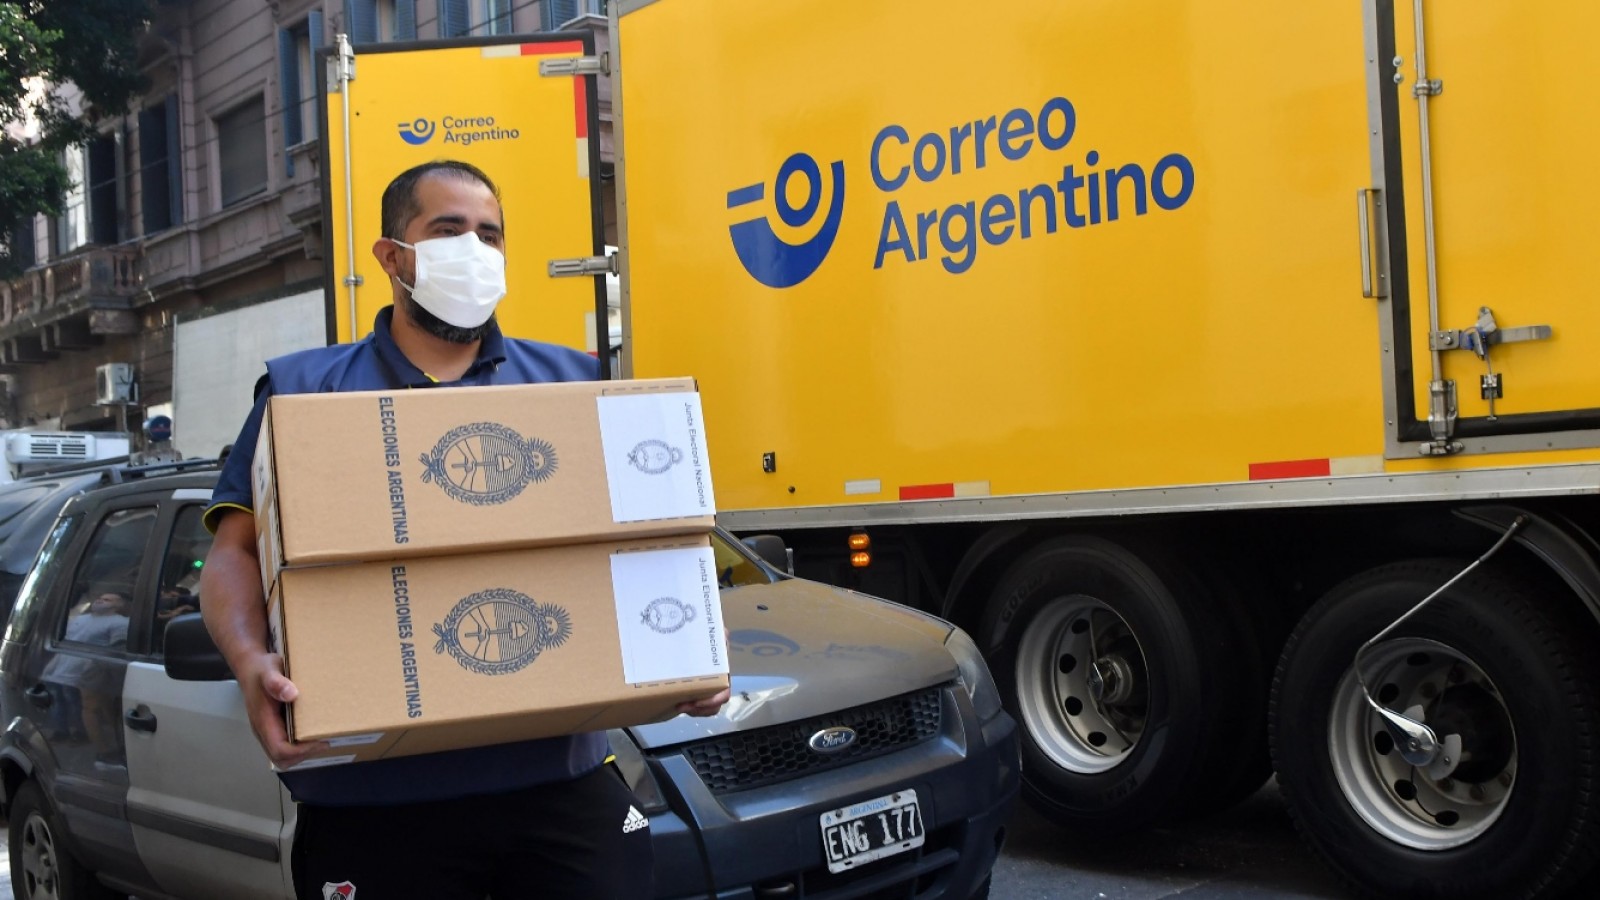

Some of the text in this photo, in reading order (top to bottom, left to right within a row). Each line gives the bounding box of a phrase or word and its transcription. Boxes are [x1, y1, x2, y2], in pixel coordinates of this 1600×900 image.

[442, 116, 495, 129] Correo
[443, 127, 520, 146] Argentino
[870, 96, 1076, 192] Correo
[873, 150, 1195, 274] Argentino
[378, 397, 409, 544] ELECCIONES ARGENTINAS
[684, 402, 707, 508] Junta Electoral Nacional
[391, 566, 422, 719] ELECCIONES ARGENTINAS
[698, 557, 720, 666] Junta Electoral Nacional
[822, 731, 848, 748] Ford
[827, 804, 916, 860] ENG 177
[849, 800, 889, 817] ARGENTINA
